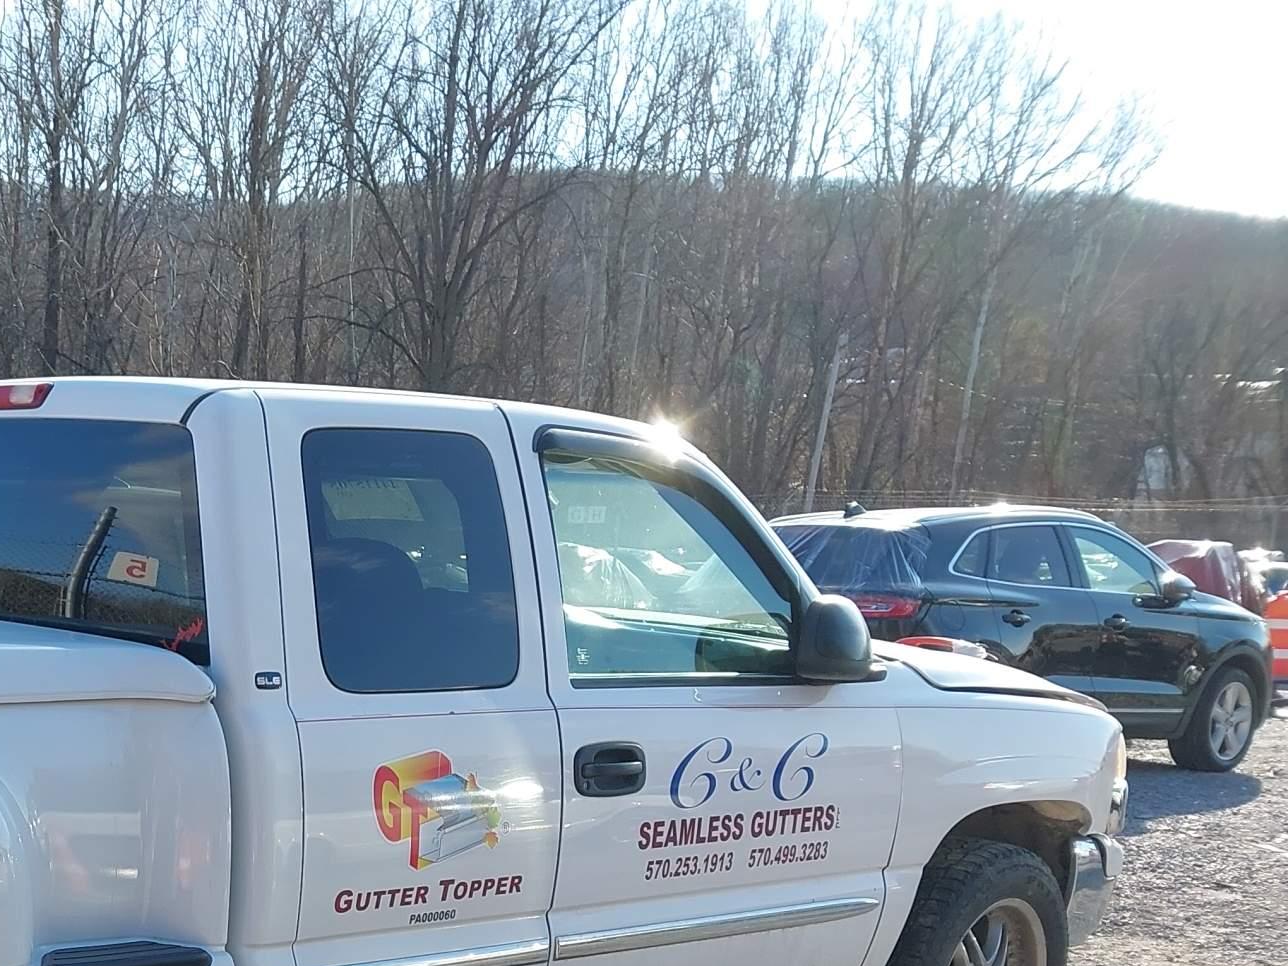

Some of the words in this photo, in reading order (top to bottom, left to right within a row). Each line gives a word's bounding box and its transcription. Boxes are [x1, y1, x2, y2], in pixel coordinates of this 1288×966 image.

[669, 736, 733, 809] C
[772, 732, 829, 801] C
[638, 813, 744, 850] SEAMLESS
[751, 804, 835, 838] GUTTERS
[644, 851, 734, 881] 570.253.1913
[748, 841, 829, 869] 570.499.3283
[409, 909, 456, 925] PA000060
